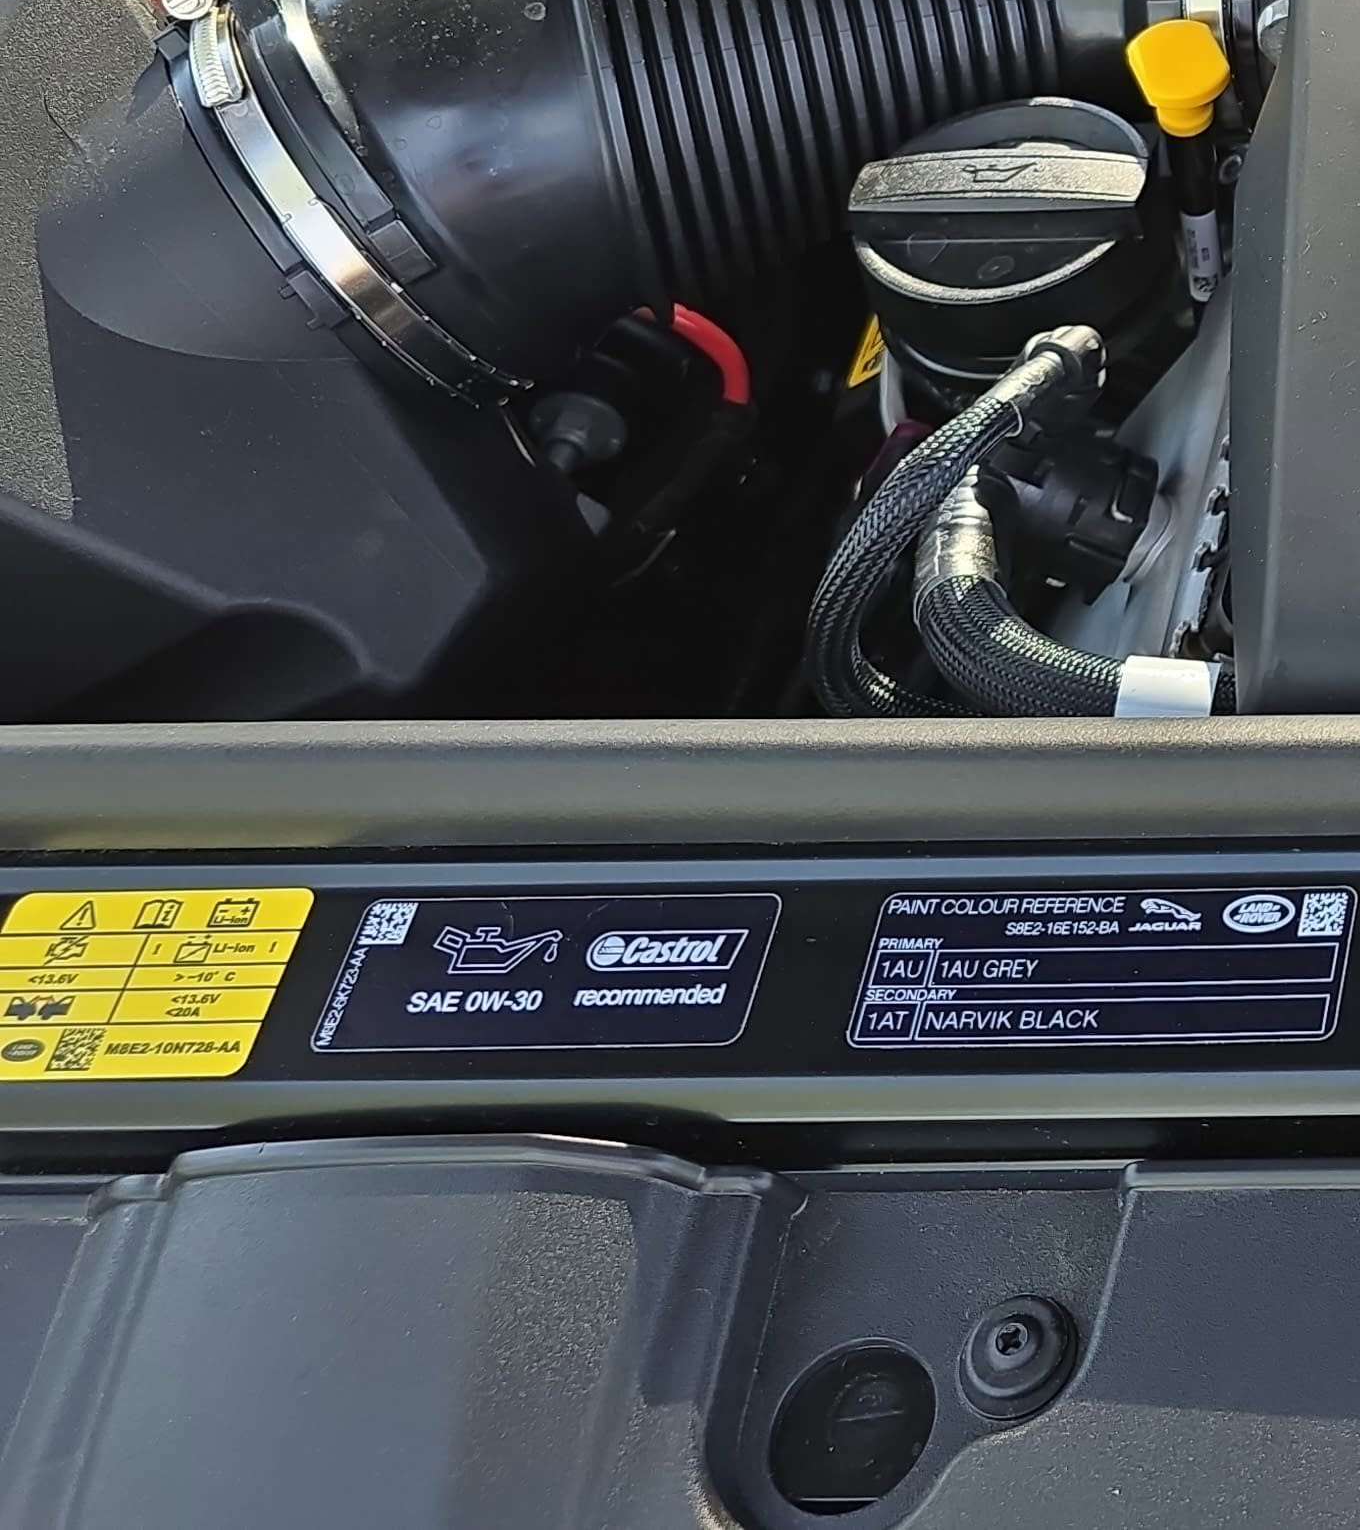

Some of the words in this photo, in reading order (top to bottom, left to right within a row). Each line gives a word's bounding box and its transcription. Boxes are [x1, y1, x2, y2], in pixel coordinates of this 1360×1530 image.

[887, 899, 940, 916] PAINT
[942, 898, 1020, 915] COLOUR
[1021, 896, 1127, 914] REFERENCE
[1238, 902, 1273, 912] LAND
[1128, 921, 1201, 932] JAGUAR
[1239, 912, 1281, 923] ROVER
[622, 935, 727, 965] Castrol
[879, 937, 943, 950] PRIMARY
[881, 960, 923, 979] 1AU
[940, 960, 981, 979] 1AU
[983, 959, 1038, 979] GREY
[406, 991, 463, 1013] SAE
[464, 990, 544, 1013] 0W-30
[573, 983, 727, 1008] recommended
[865, 988, 956, 1001] SECONDARY
[867, 1011, 908, 1031] 1AT
[924, 1010, 1013, 1031] NARVIK
[1019, 1009, 1099, 1030] BLACK
